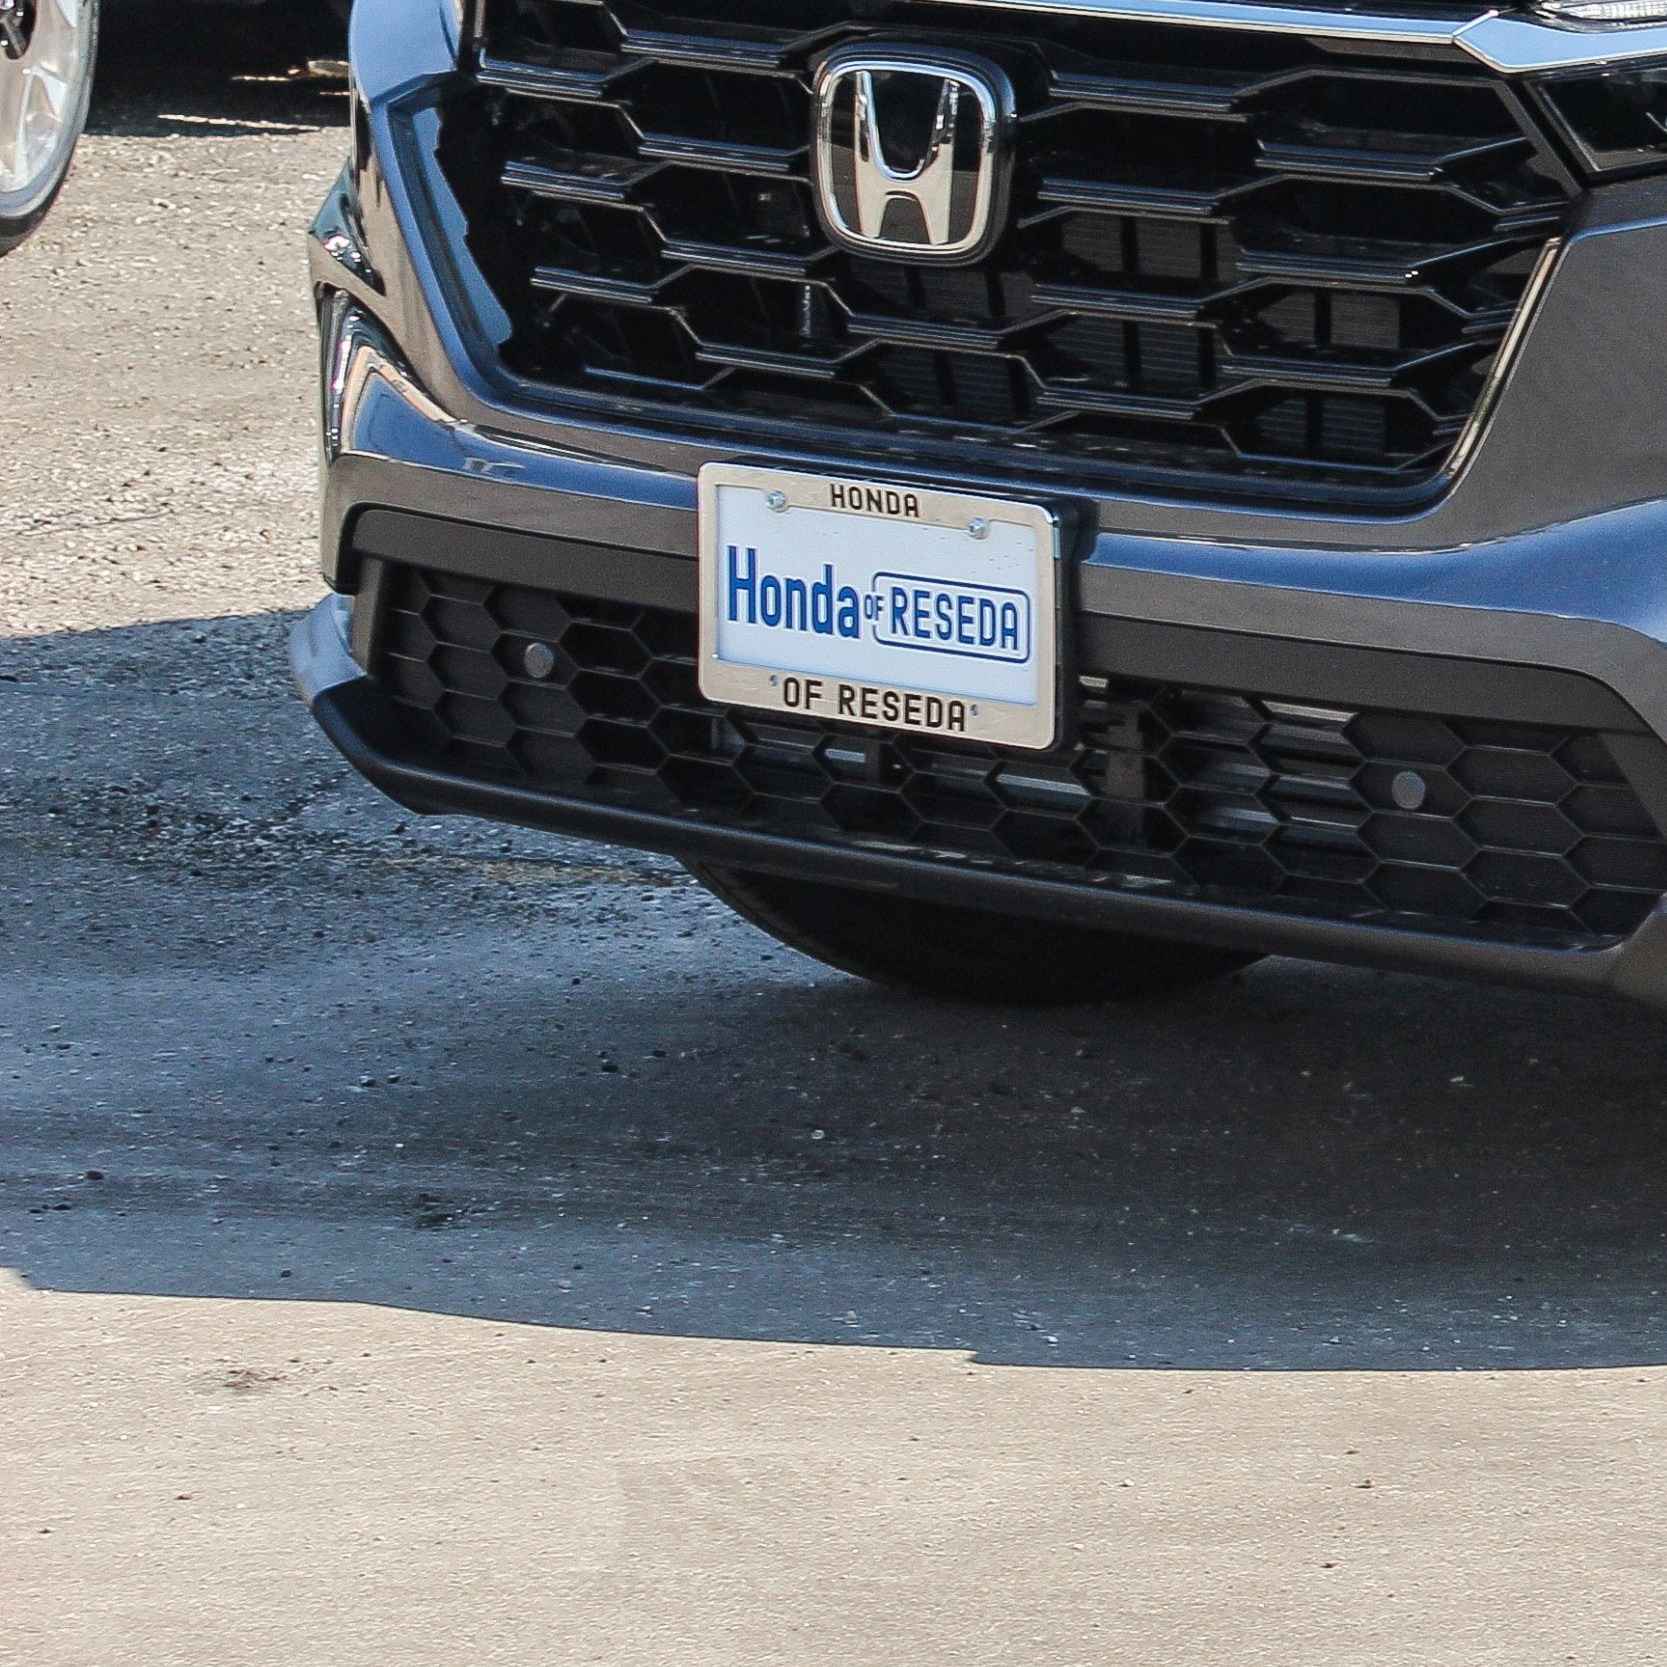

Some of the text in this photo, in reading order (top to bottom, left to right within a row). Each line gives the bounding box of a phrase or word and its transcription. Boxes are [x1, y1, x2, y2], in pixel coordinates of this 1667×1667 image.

[829, 482, 919, 518] HONDA
[727, 545, 1019, 651] Honda OF RESEDA
[783, 676, 966, 732] OF RESEDA
